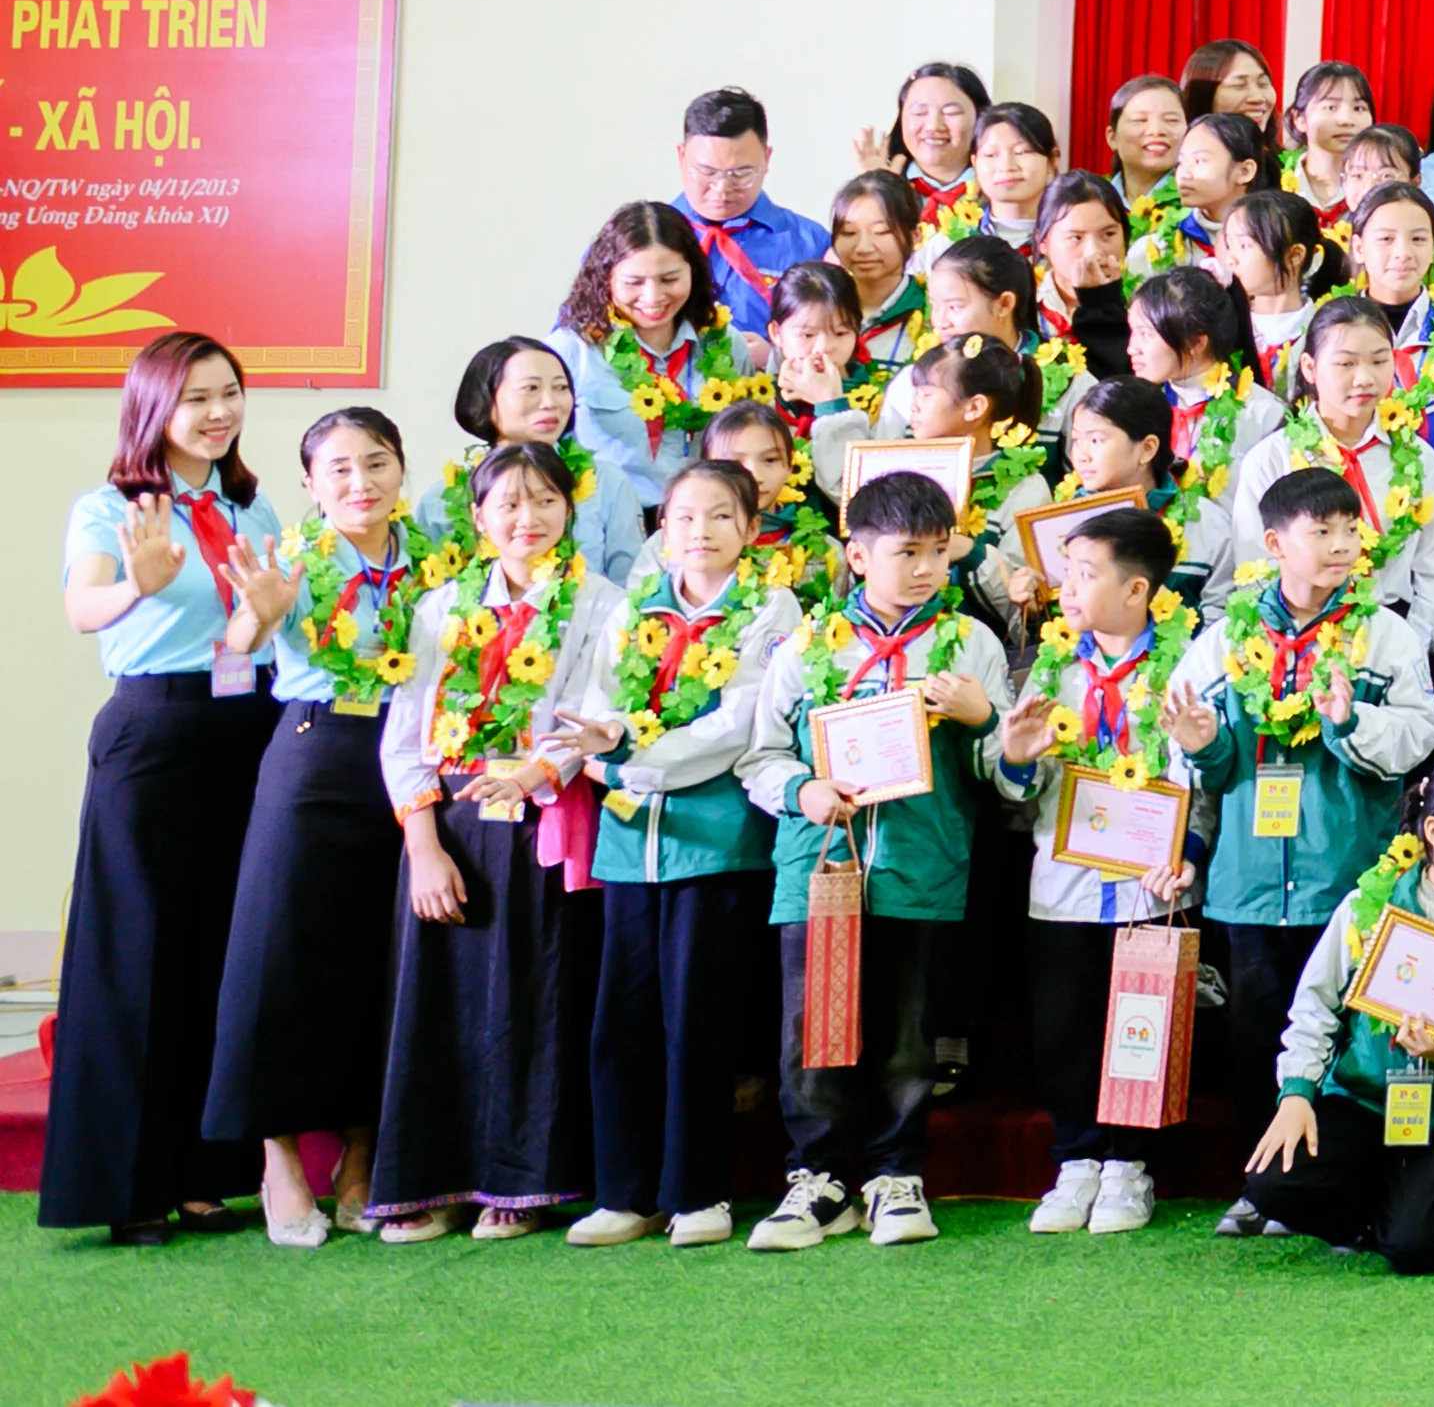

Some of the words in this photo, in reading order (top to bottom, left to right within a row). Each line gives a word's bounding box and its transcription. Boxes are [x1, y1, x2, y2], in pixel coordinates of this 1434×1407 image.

[36, 87, 99, 150] XÃ
[115, 86, 200, 166] HỘI.
[85, 179, 135, 201] ngày
[139, 178, 240, 200] 04/11/2013
[26, 204, 80, 230] Ương
[85, 205, 140, 230] Đảng
[144, 207, 194, 225] khóa
[198, 207, 229, 228] XI)
